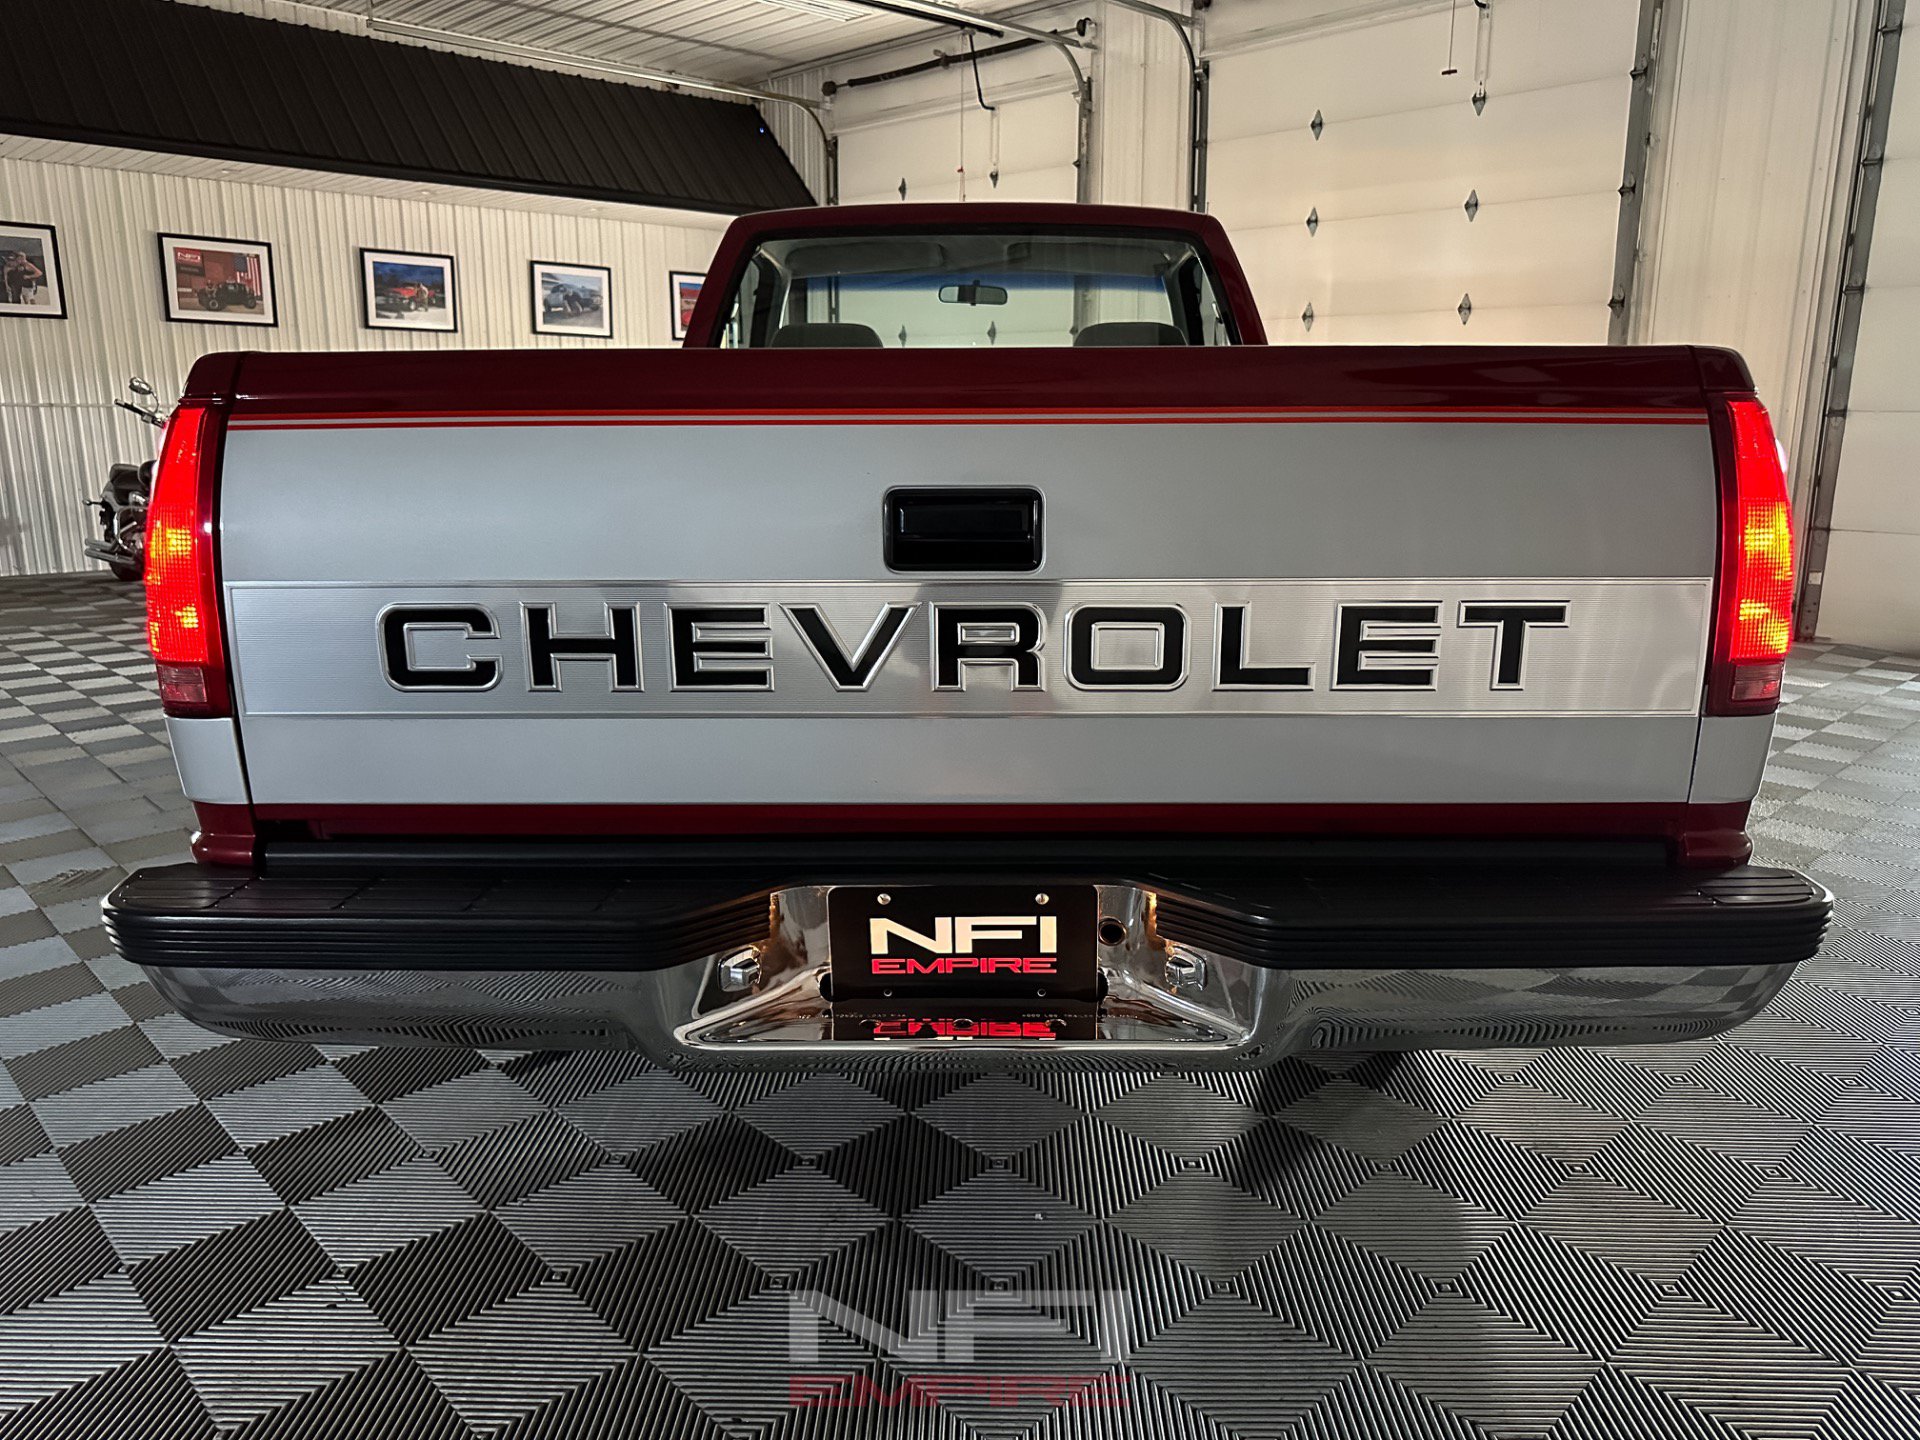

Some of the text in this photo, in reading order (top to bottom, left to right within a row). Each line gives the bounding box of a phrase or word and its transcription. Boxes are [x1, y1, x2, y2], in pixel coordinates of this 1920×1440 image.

[377, 602, 1569, 692] CHEVROLET
[870, 916, 1057, 954] NFI
[871, 957, 1057, 974] EMPIRE
